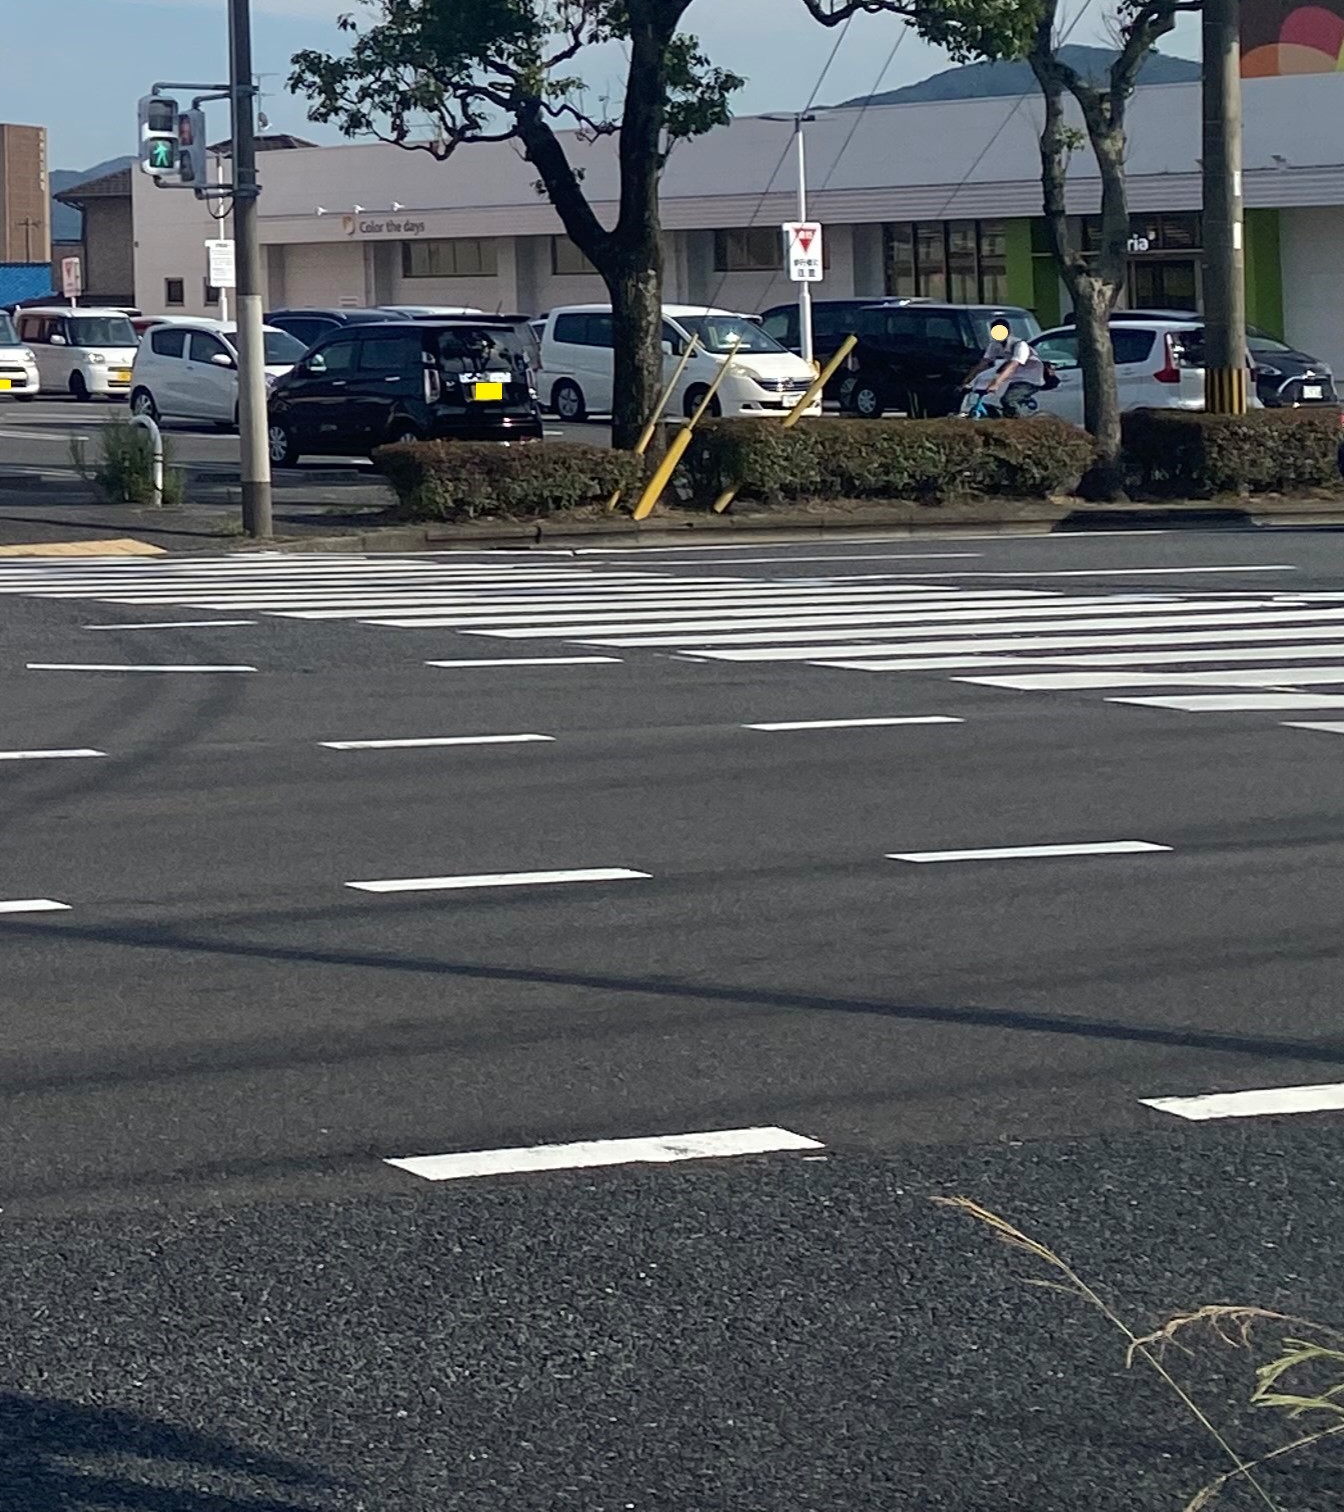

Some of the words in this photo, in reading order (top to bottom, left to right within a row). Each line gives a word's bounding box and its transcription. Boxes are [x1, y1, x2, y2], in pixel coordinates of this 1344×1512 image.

[359, 221, 384, 234] Color
[386, 220, 402, 233] the
[404, 220, 425, 236] days
